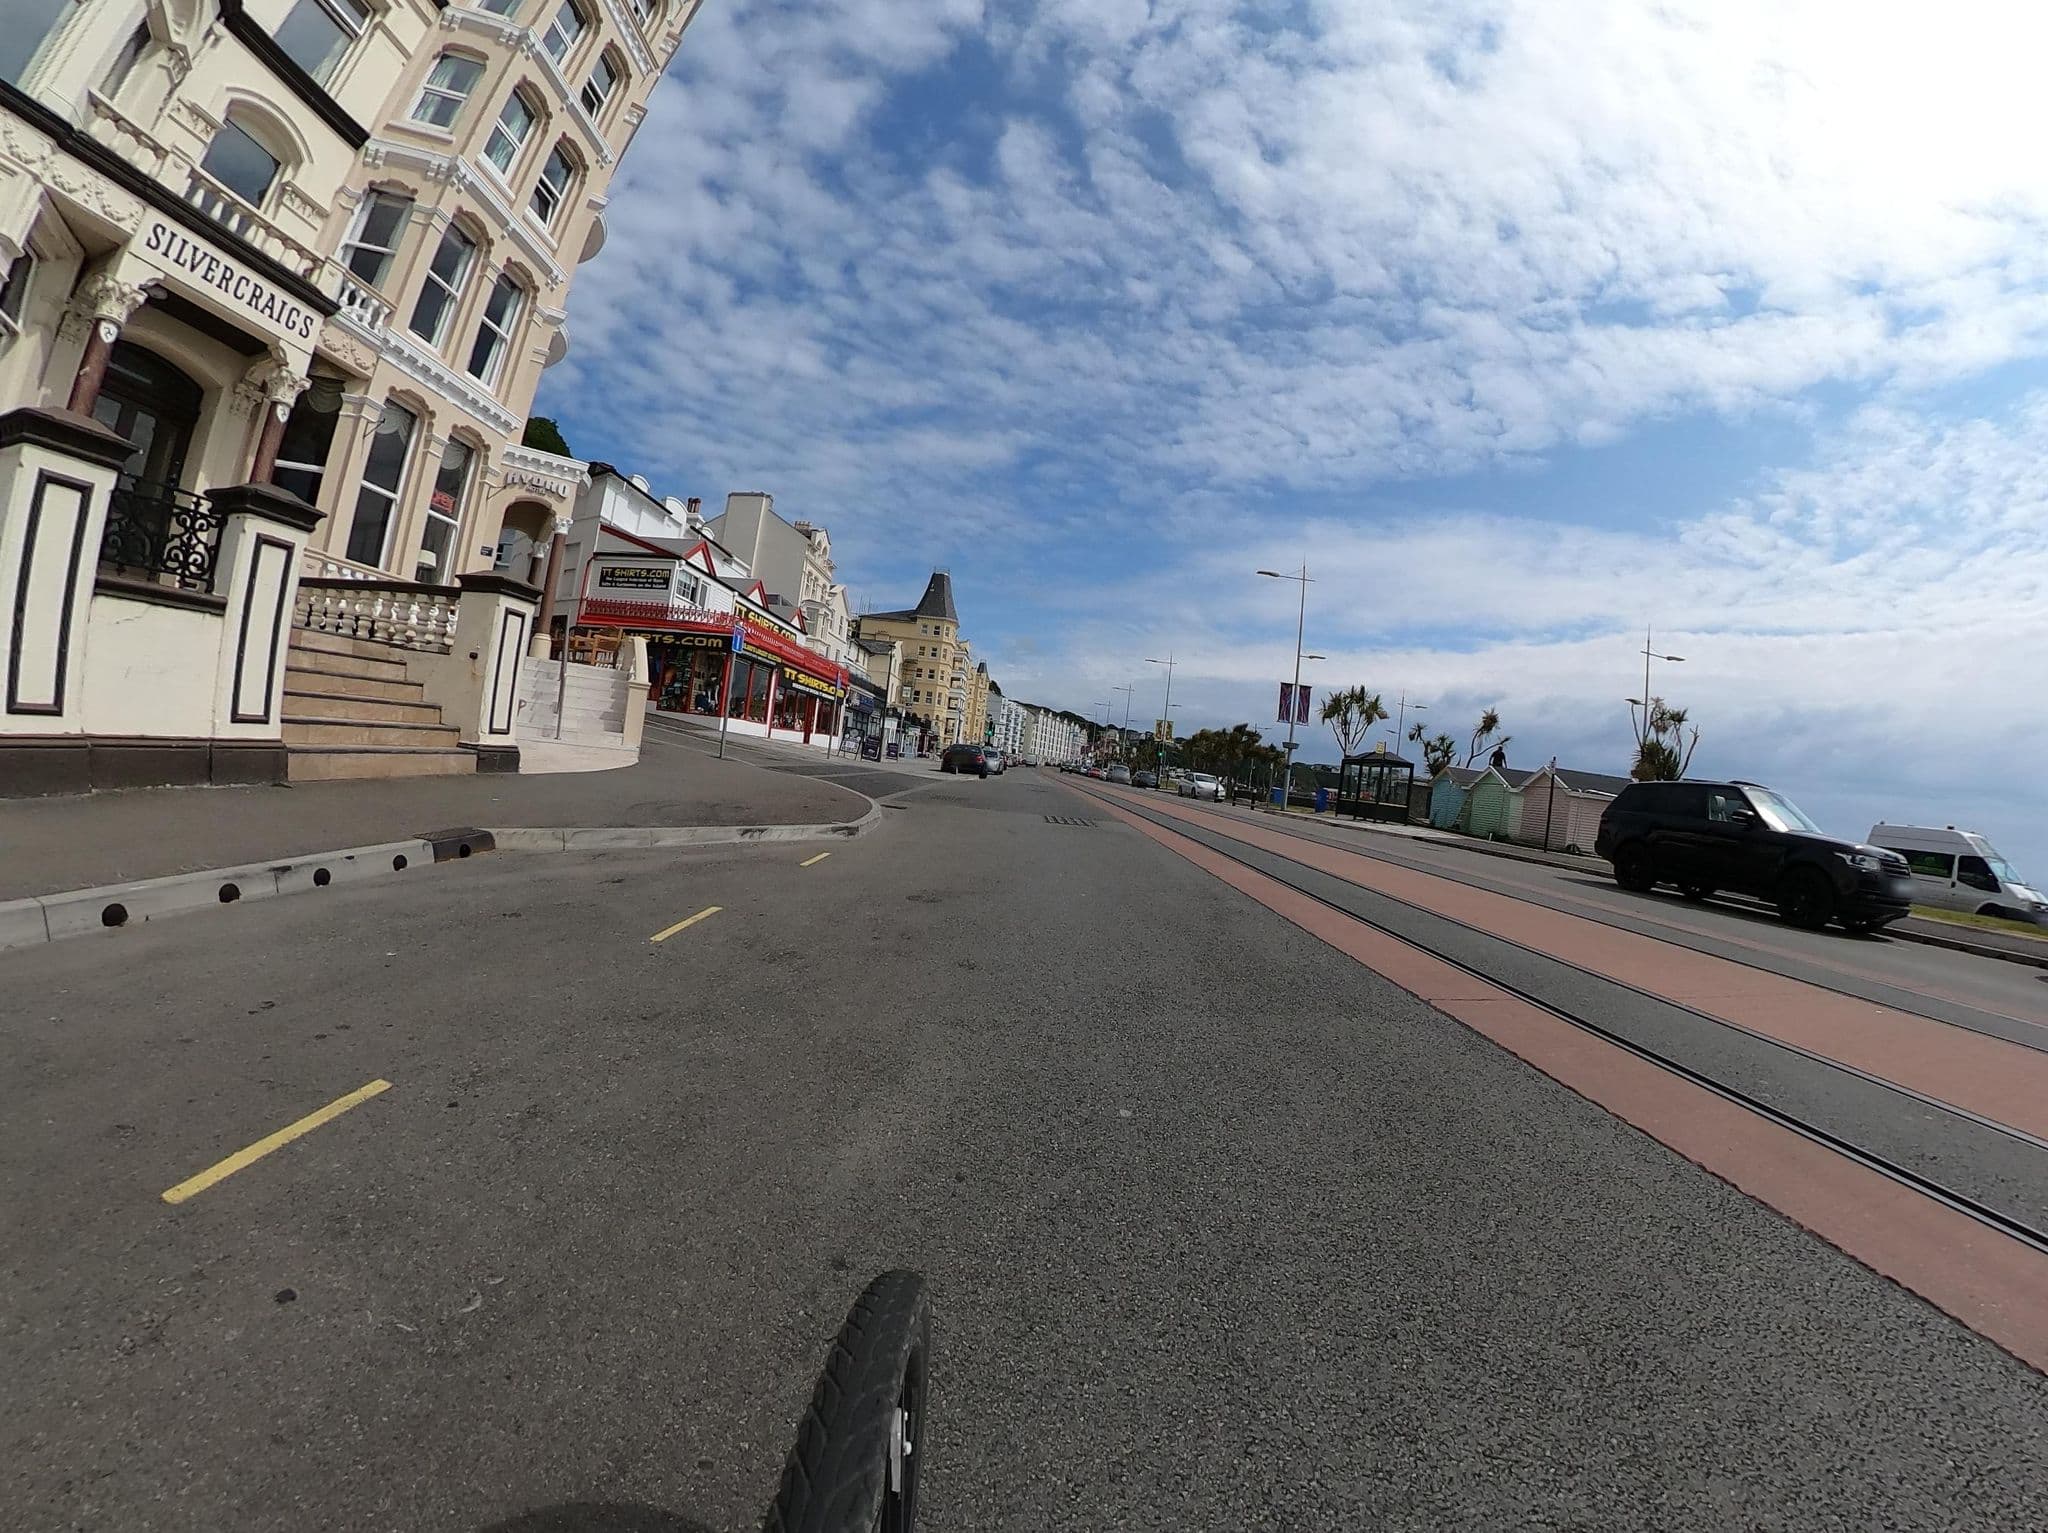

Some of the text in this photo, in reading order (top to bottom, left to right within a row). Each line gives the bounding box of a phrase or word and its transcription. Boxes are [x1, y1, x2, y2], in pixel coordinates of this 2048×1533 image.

[146, 223, 313, 338] SILVERCRAIGS
[504, 470, 569, 499] HYDRO
[602, 568, 670, 578] TT SHIRTS.COM
[735, 602, 747, 618] TT
[783, 667, 798, 680] TT
